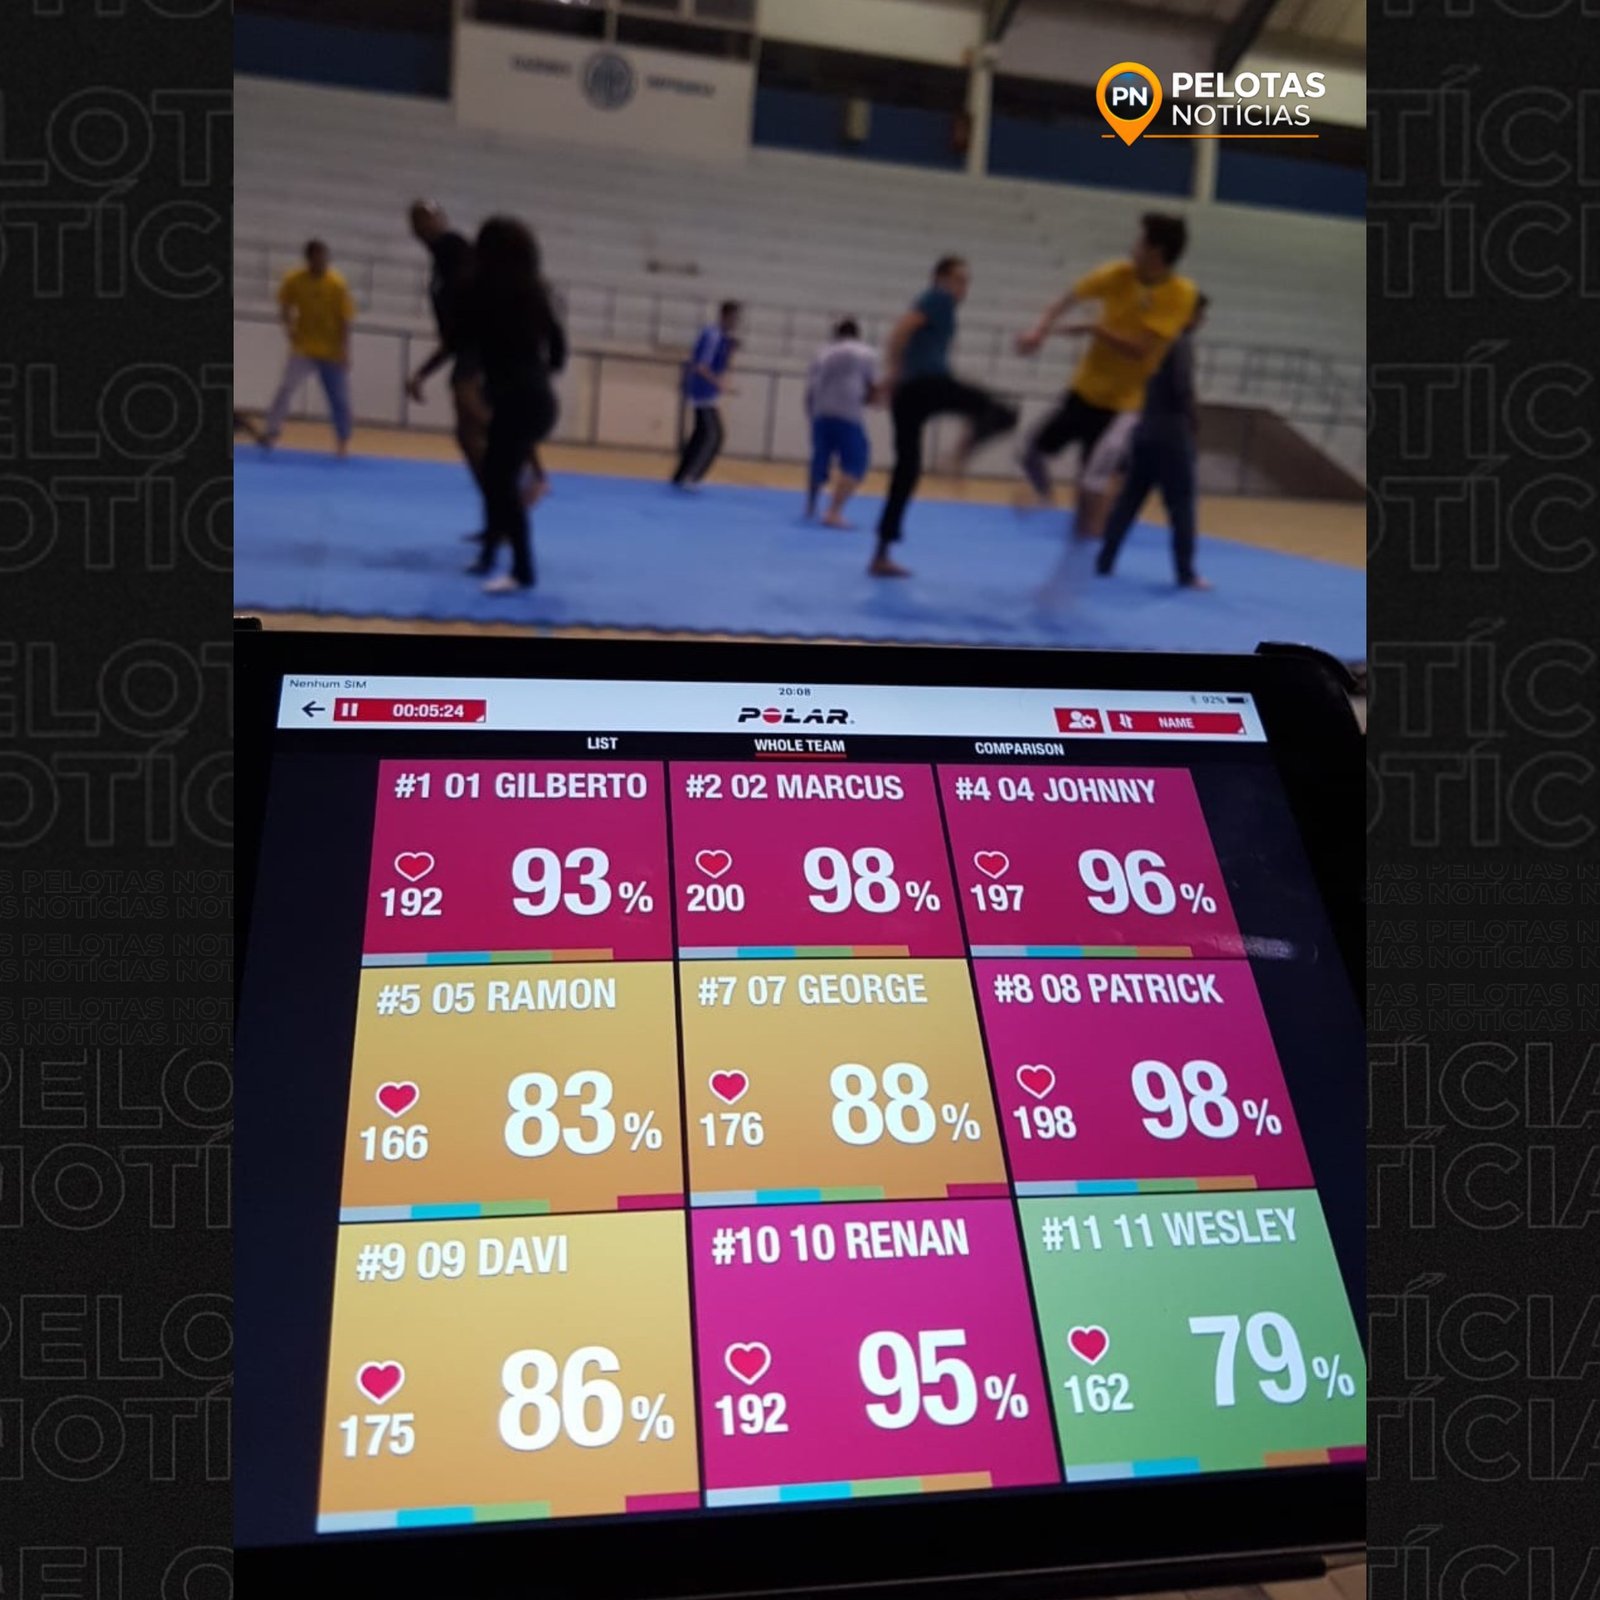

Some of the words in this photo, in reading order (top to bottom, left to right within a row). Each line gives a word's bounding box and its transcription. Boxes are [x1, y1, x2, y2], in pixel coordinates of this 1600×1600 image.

[289, 679, 341, 689] Nenhum
[344, 680, 367, 689] SIM
[779, 687, 811, 696] 20:08
[393, 703, 464, 718] 00:05:24
[738, 707, 850, 724] POLAR
[1158, 716, 1195, 729] NAME
[587, 737, 618, 750] LIST
[754, 738, 803, 752] WHOLE
[805, 740, 845, 753] TEAM
[974, 741, 1064, 756] COMPARISON
[394, 772, 431, 798] #1
[445, 772, 480, 799] 01
[495, 772, 647, 799] GILBERTO
[685, 773, 723, 799] #2
[731, 774, 768, 799] 02
[776, 774, 904, 800] MARCUS
[955, 776, 992, 801] #4
[998, 777, 1035, 802] 04
[1043, 777, 1155, 804] JOHNNY
[380, 887, 443, 917] 192
[686, 883, 745, 912] 200
[970, 884, 1024, 911] 197
[376, 983, 421, 1015] #5
[432, 982, 476, 1014] 05
[487, 978, 616, 1012] RAMON
[698, 976, 737, 1006] #7
[747, 975, 787, 1005] 07
[798, 973, 928, 1005] GEORGE
[994, 973, 1034, 1003] #8
[1040, 973, 1082, 1004] 08
[1087, 973, 1224, 1004] PATRICK
[699, 1111, 764, 1147] 176
[1013, 1105, 1077, 1139] 198
[360, 1124, 429, 1161] 166
[711, 1225, 781, 1265] #10
[790, 1223, 836, 1262] 10
[844, 1218, 970, 1260] RENAN
[1041, 1215, 1102, 1251] #11
[1113, 1213, 1154, 1248] 11
[1161, 1207, 1296, 1246] WESLEY
[356, 1242, 406, 1281] #9
[417, 1240, 466, 1279] 09
[478, 1235, 568, 1276] DAVI
[1063, 1372, 1134, 1413] 162
[715, 1392, 789, 1436] 192
[339, 1412, 415, 1457] 175
